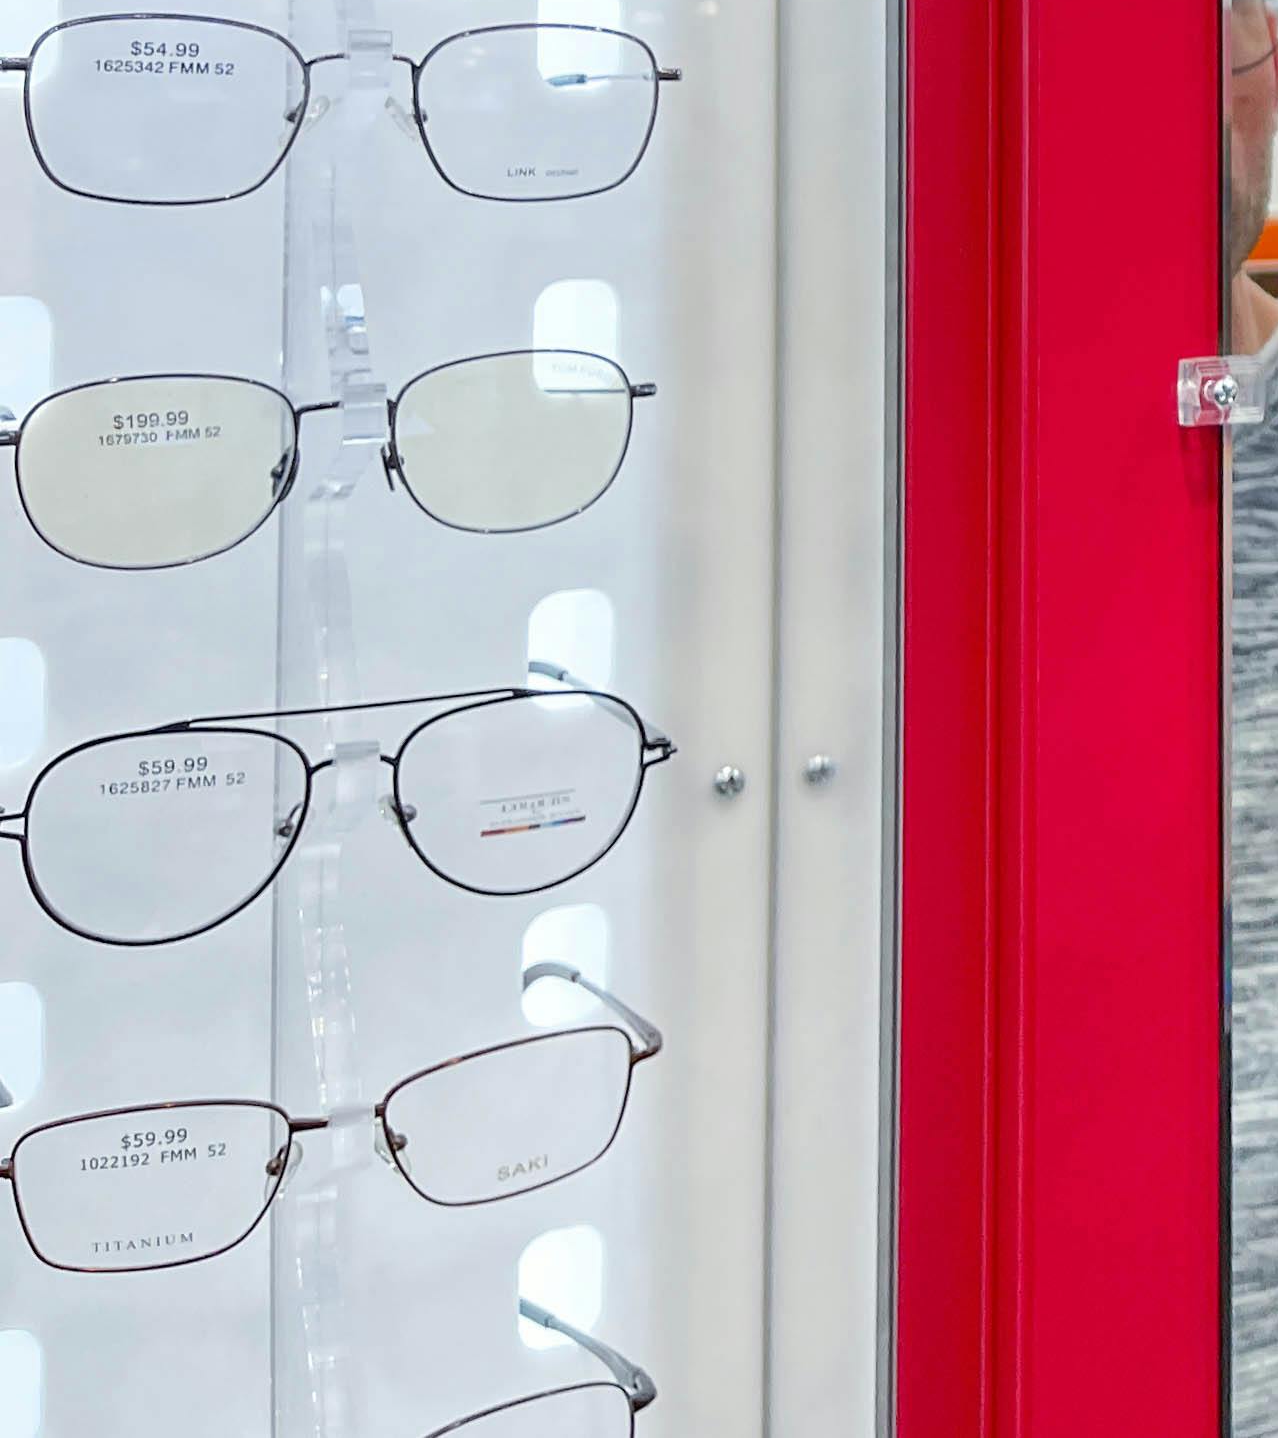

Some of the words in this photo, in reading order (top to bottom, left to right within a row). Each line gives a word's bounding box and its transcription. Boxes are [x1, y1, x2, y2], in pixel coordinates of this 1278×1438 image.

[130, 40, 199, 58] $54.99
[95, 59, 164, 74] 1625342
[168, 61, 209, 75] FMM
[214, 62, 235, 76] 52
[113, 410, 189, 430] $199.99
[166, 427, 200, 441] FMM
[138, 756, 208, 777] $59.99
[100, 778, 171, 795] 1625827
[176, 774, 216, 791] FMM
[226, 771, 246, 787] 52
[121, 1128, 188, 1151] $59.99
[81, 1152, 150, 1171] 1022192
[160, 1147, 197, 1164] FMM
[208, 1143, 227, 1158] 52
[92, 1232, 193, 1253] TITANIUM
